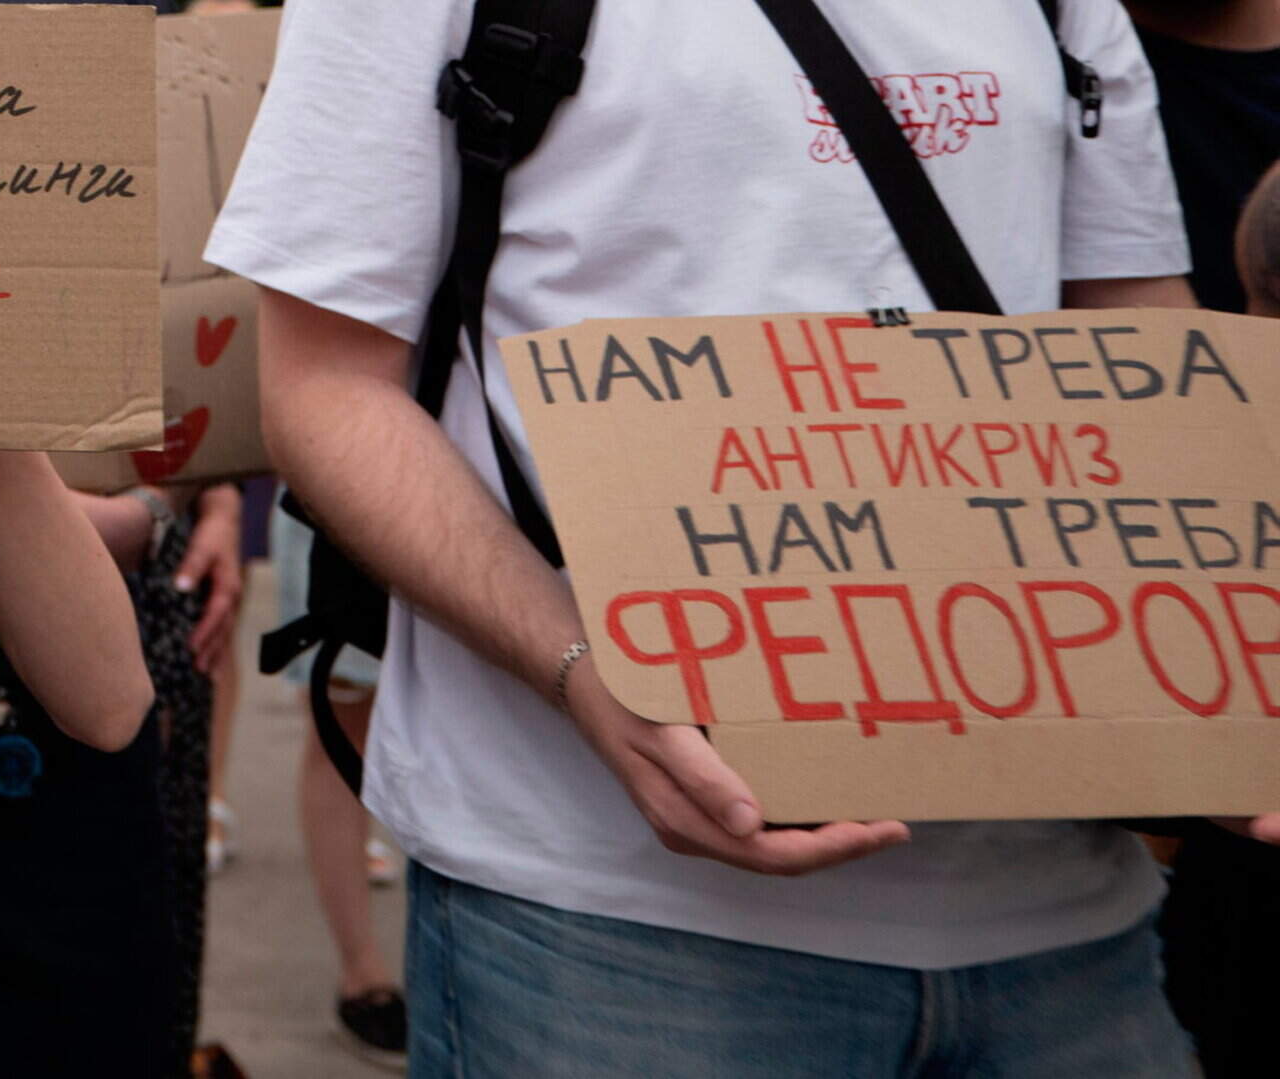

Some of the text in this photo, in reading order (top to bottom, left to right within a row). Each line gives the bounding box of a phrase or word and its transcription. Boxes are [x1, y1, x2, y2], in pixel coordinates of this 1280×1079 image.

[527, 316, 1251, 414] НАМ НЕ ТРЕБА
[709, 422, 1124, 494] АНТИКРИЗ
[675, 497, 897, 577] НАМ
